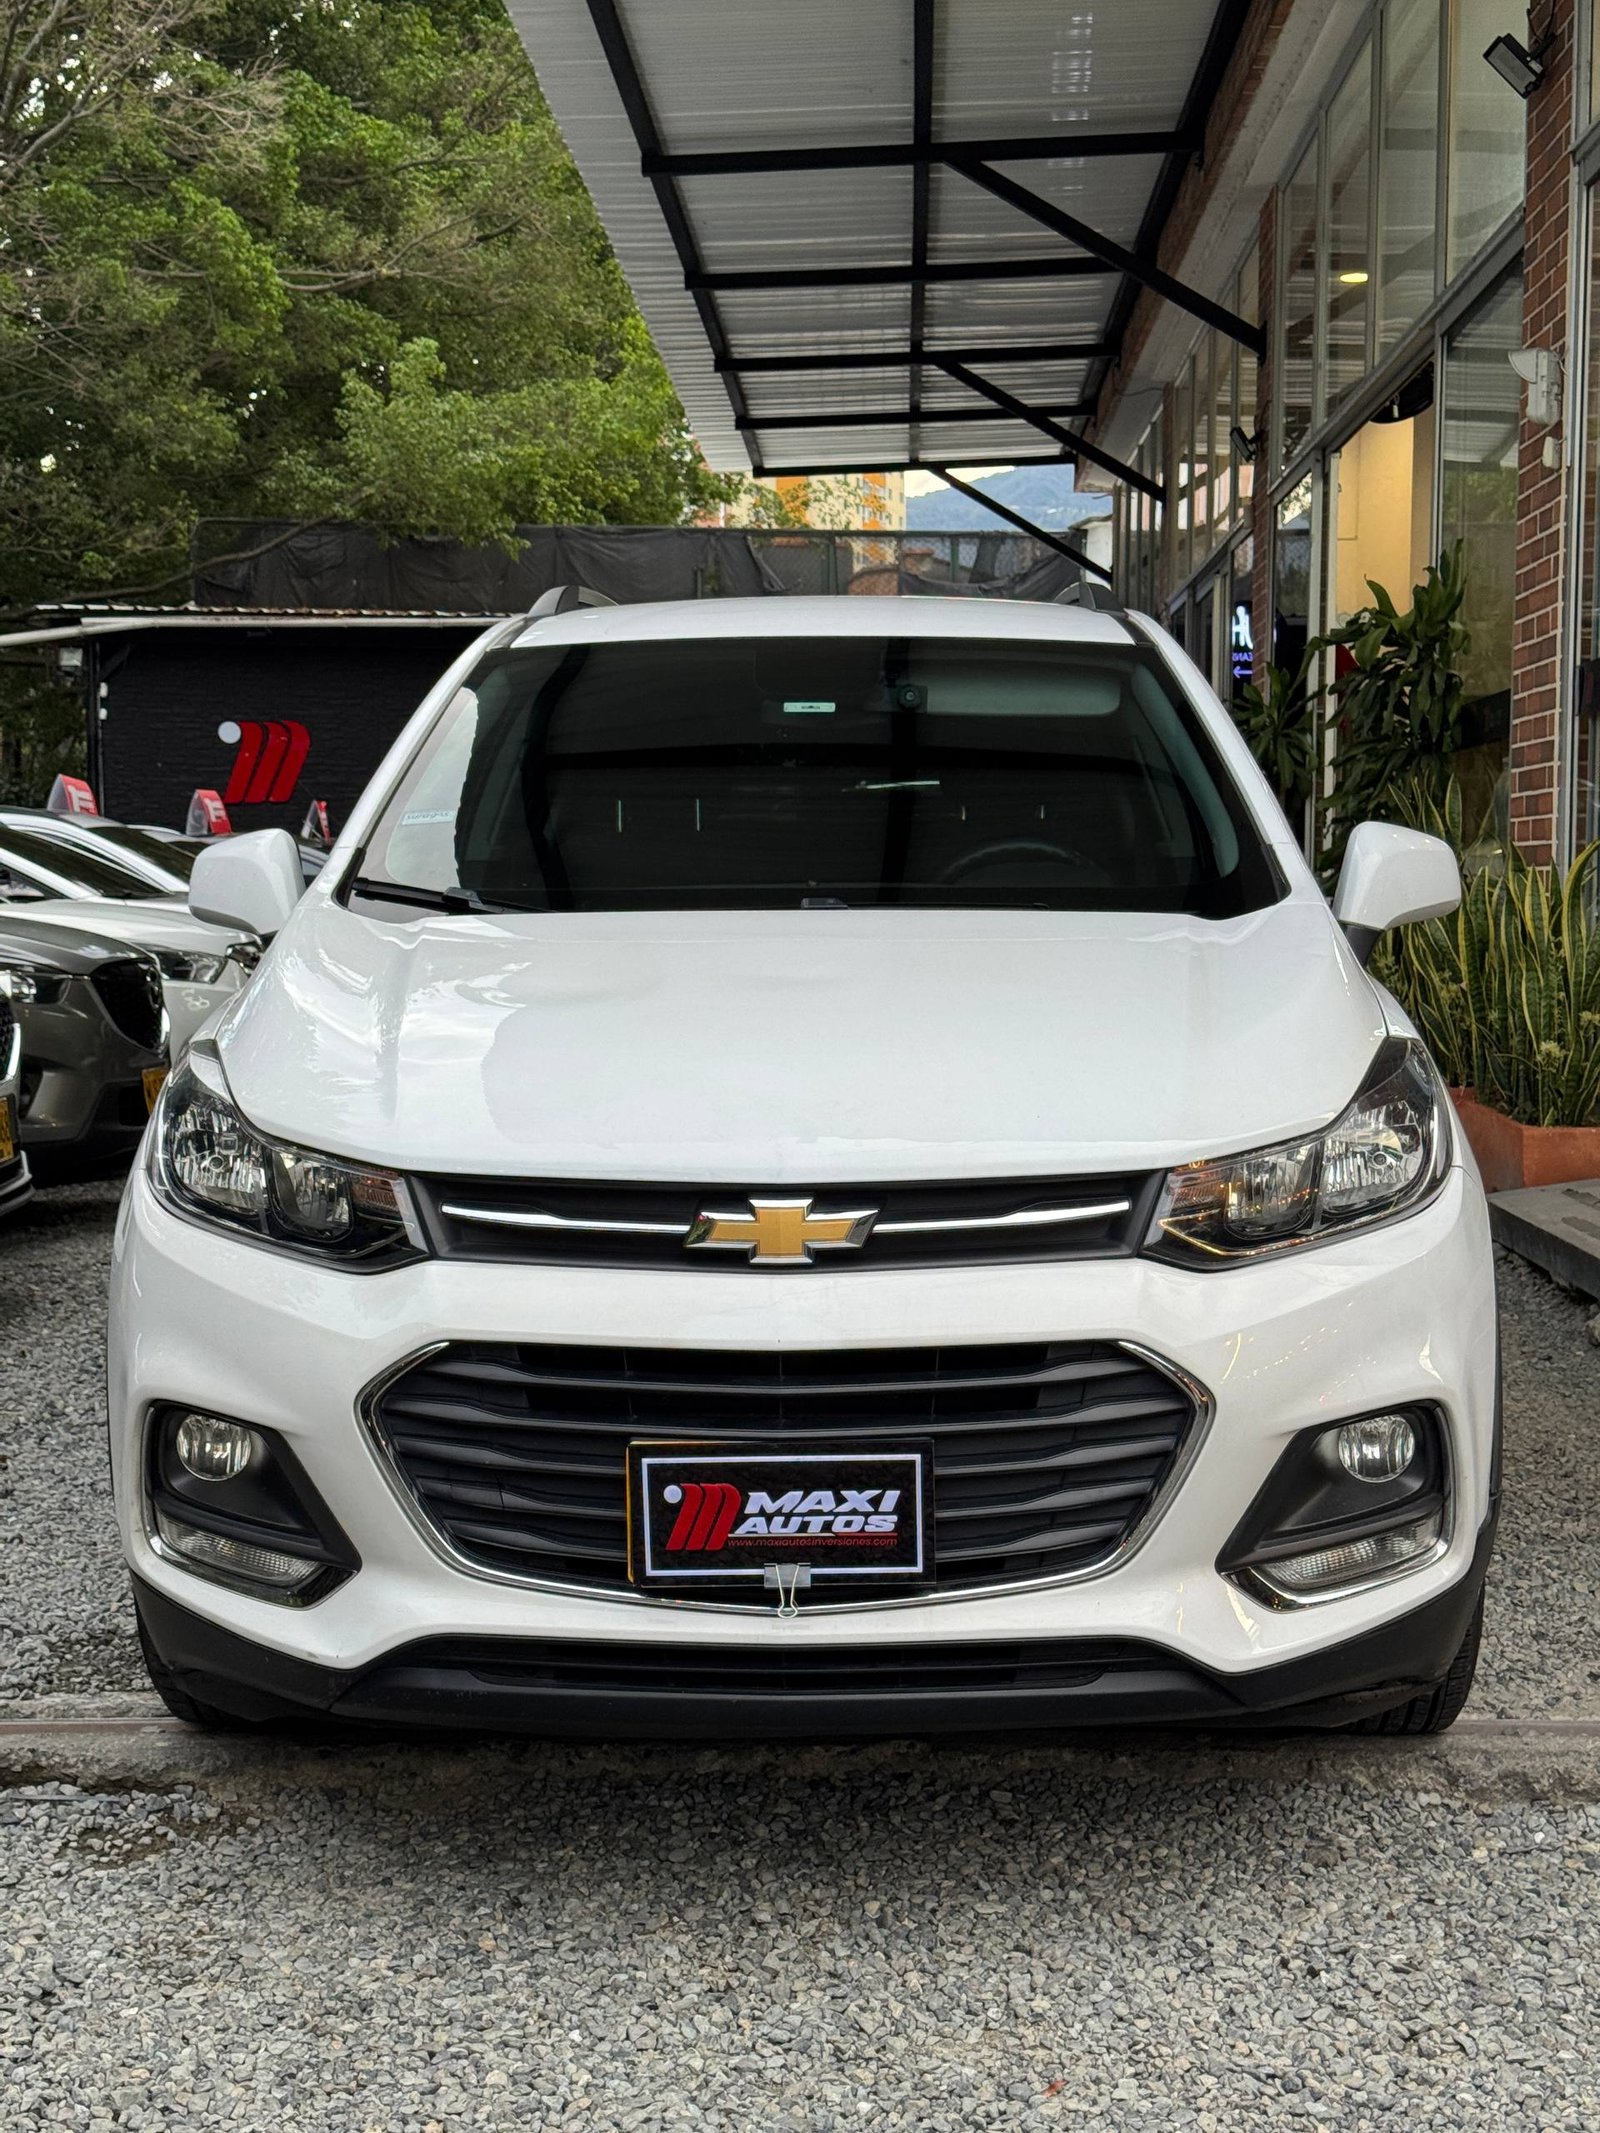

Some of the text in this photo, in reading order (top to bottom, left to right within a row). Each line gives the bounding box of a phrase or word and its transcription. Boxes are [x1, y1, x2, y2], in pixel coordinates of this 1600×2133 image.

[744, 1490, 900, 1514] MAXI
[734, 1515, 898, 1534] AUTOS
[728, 1535, 898, 1547] www.maxiautosinversiones.com
